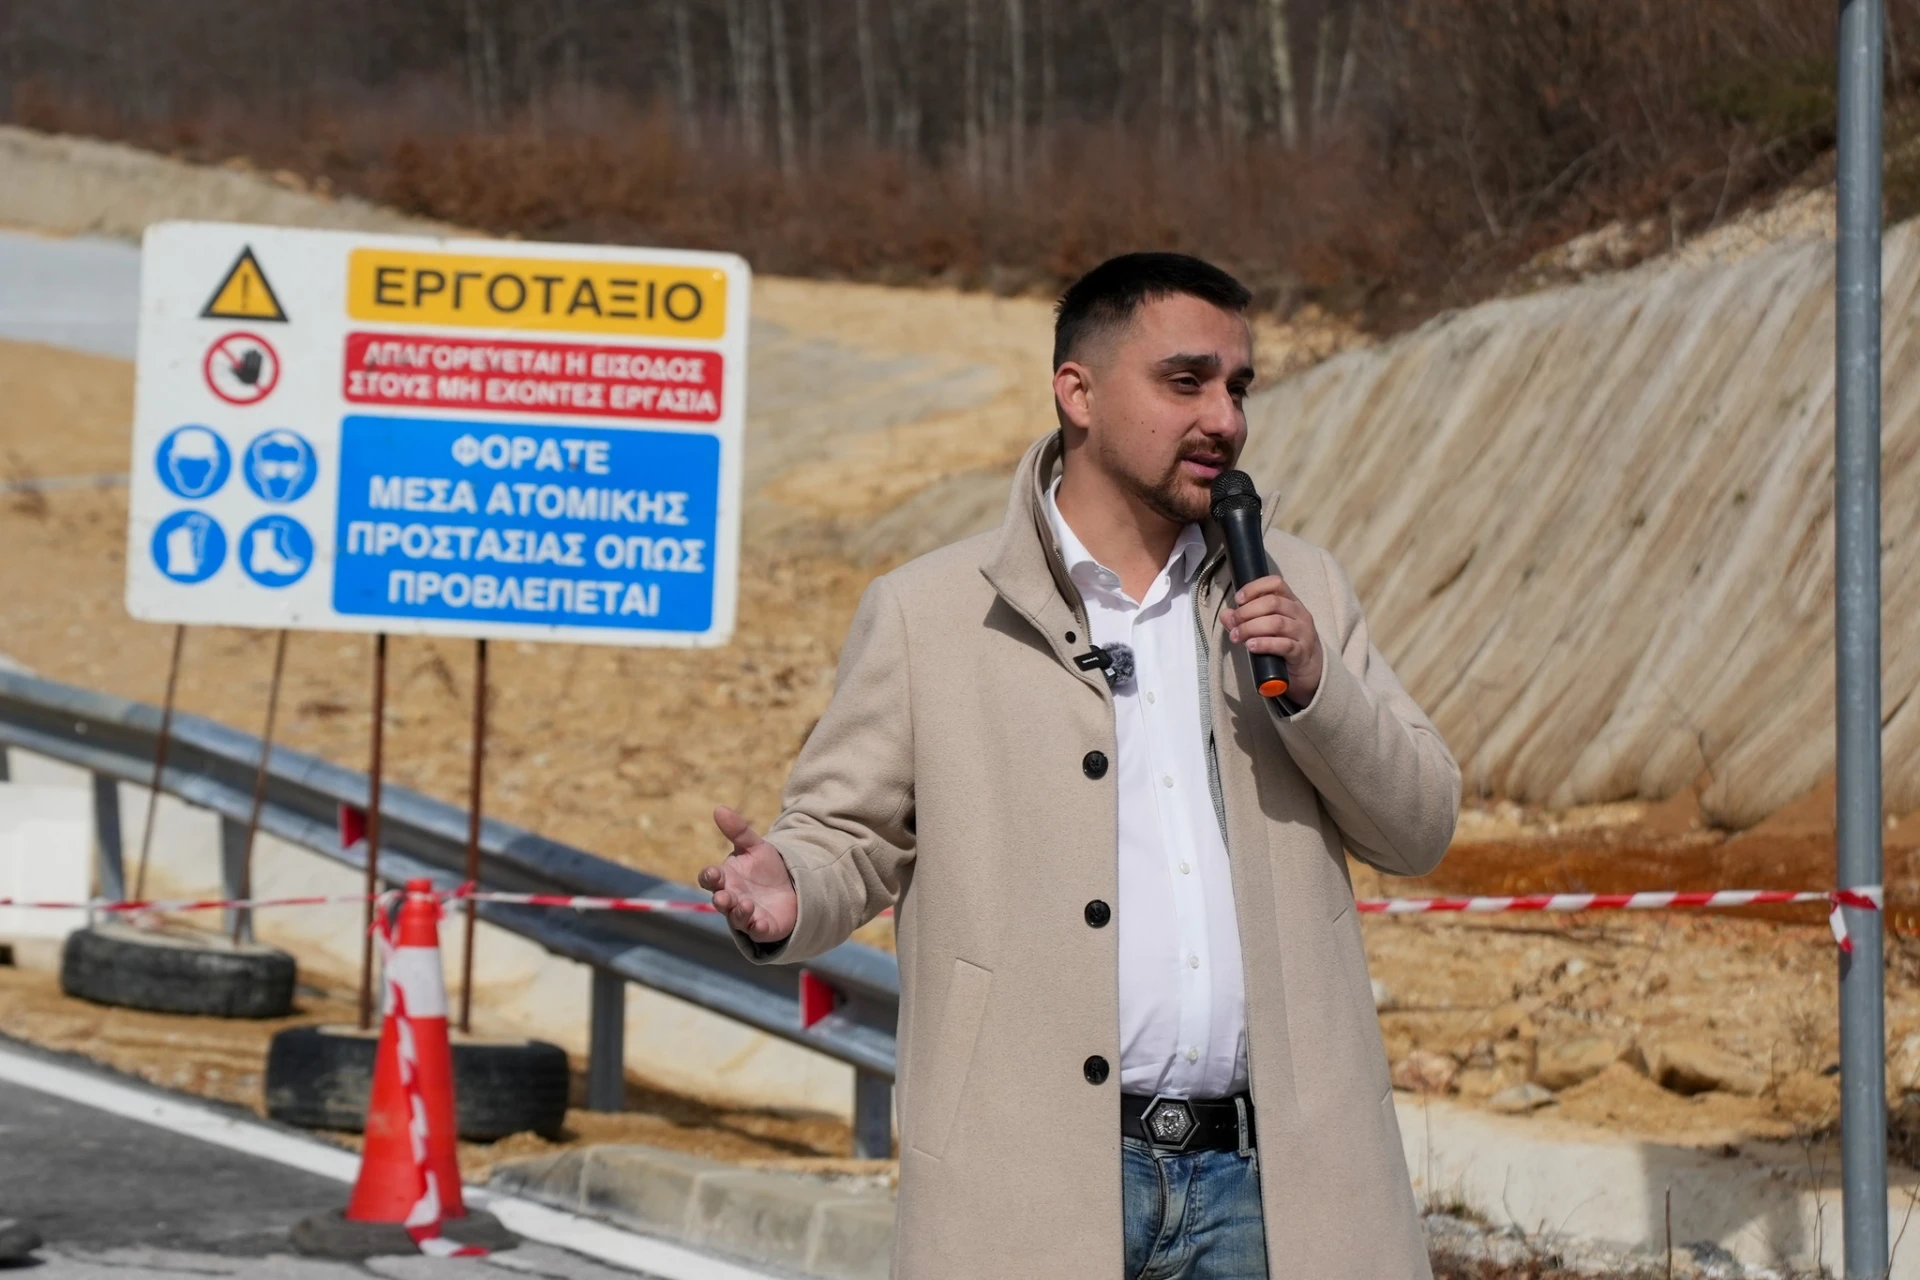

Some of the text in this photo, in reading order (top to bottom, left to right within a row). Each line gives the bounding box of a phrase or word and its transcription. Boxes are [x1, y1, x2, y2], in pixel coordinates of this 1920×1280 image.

[374, 266, 703, 322] ΕΡΓΟΤΑΞΙΟ
[363, 341, 705, 383] ΑΠΑΓΟΡΕΥΕΤΑΙ Η ΕΙΣΟΔΟΣ
[349, 370, 717, 414] ΣΤΟΥΣ ΜΗ ΕΧΟΝΤΕΣ ΕΡΓΑΣΙΑ
[452, 434, 610, 475] ΦΟΡΑΤΕ
[369, 475, 689, 526] ΜΕΣΑ ΑΤΟΜΙΚΗΣ
[347, 521, 705, 573] ΠΡΟΣΤΑΣΙΑΣ ΟΠΩΣ
[388, 570, 660, 617] ΠΡΟΒΛΕΠΕΤΑΙ
